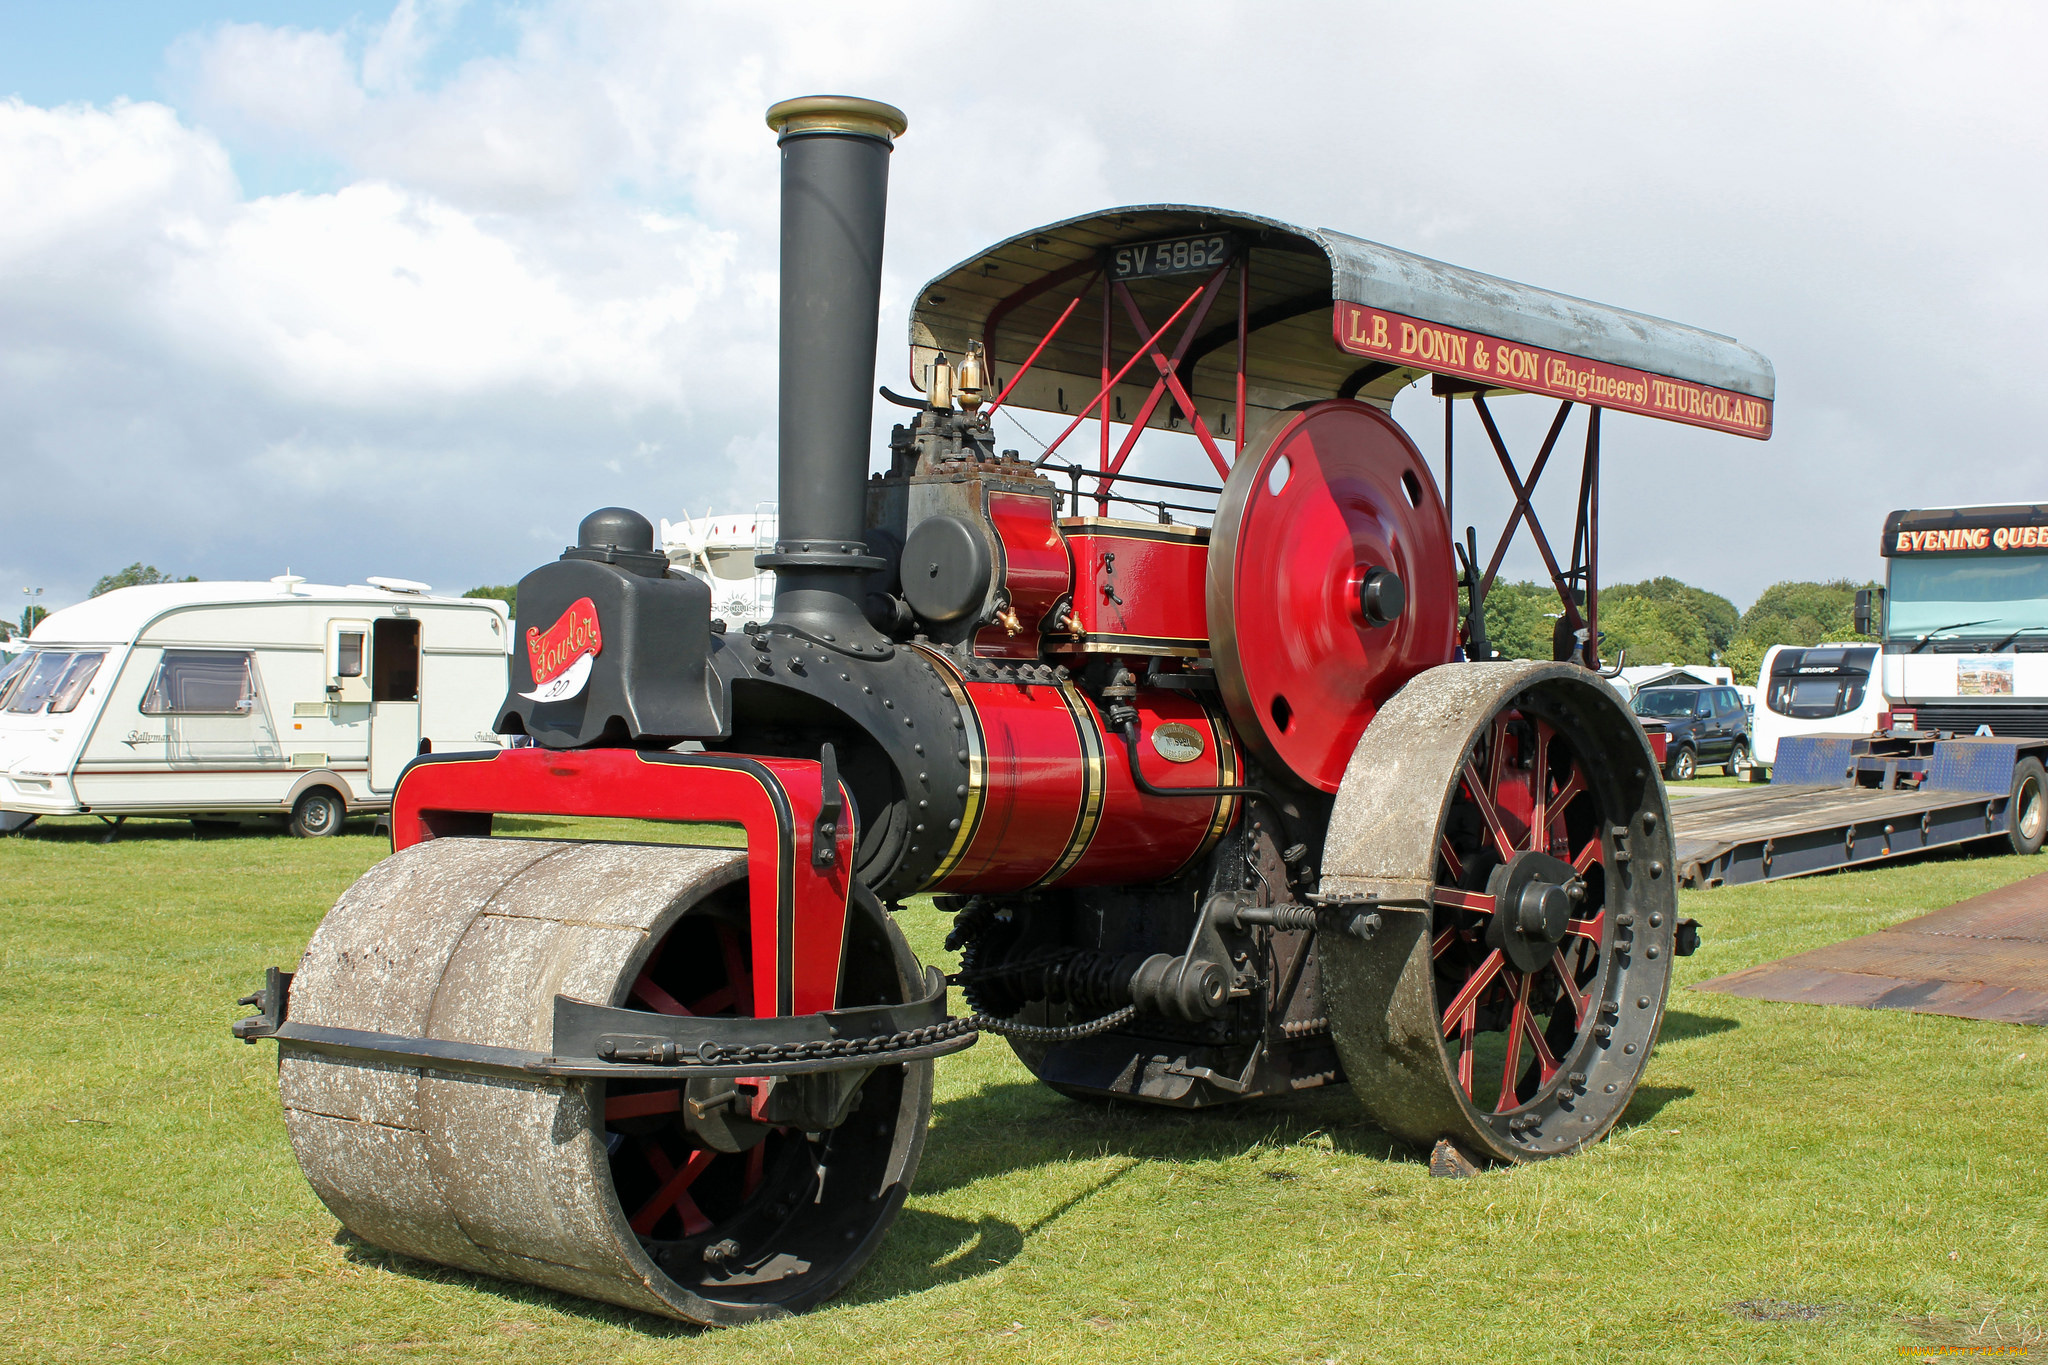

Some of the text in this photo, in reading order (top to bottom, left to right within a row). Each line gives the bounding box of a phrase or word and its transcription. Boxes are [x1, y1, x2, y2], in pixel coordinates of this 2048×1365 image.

[1115, 237, 1225, 274] SV 5862
[1349, 309, 1767, 428] L.B. DONN & SON (Engineers) THURGOLAND
[1896, 528, 1989, 551] EVENING
[530, 611, 597, 682] Fowler
